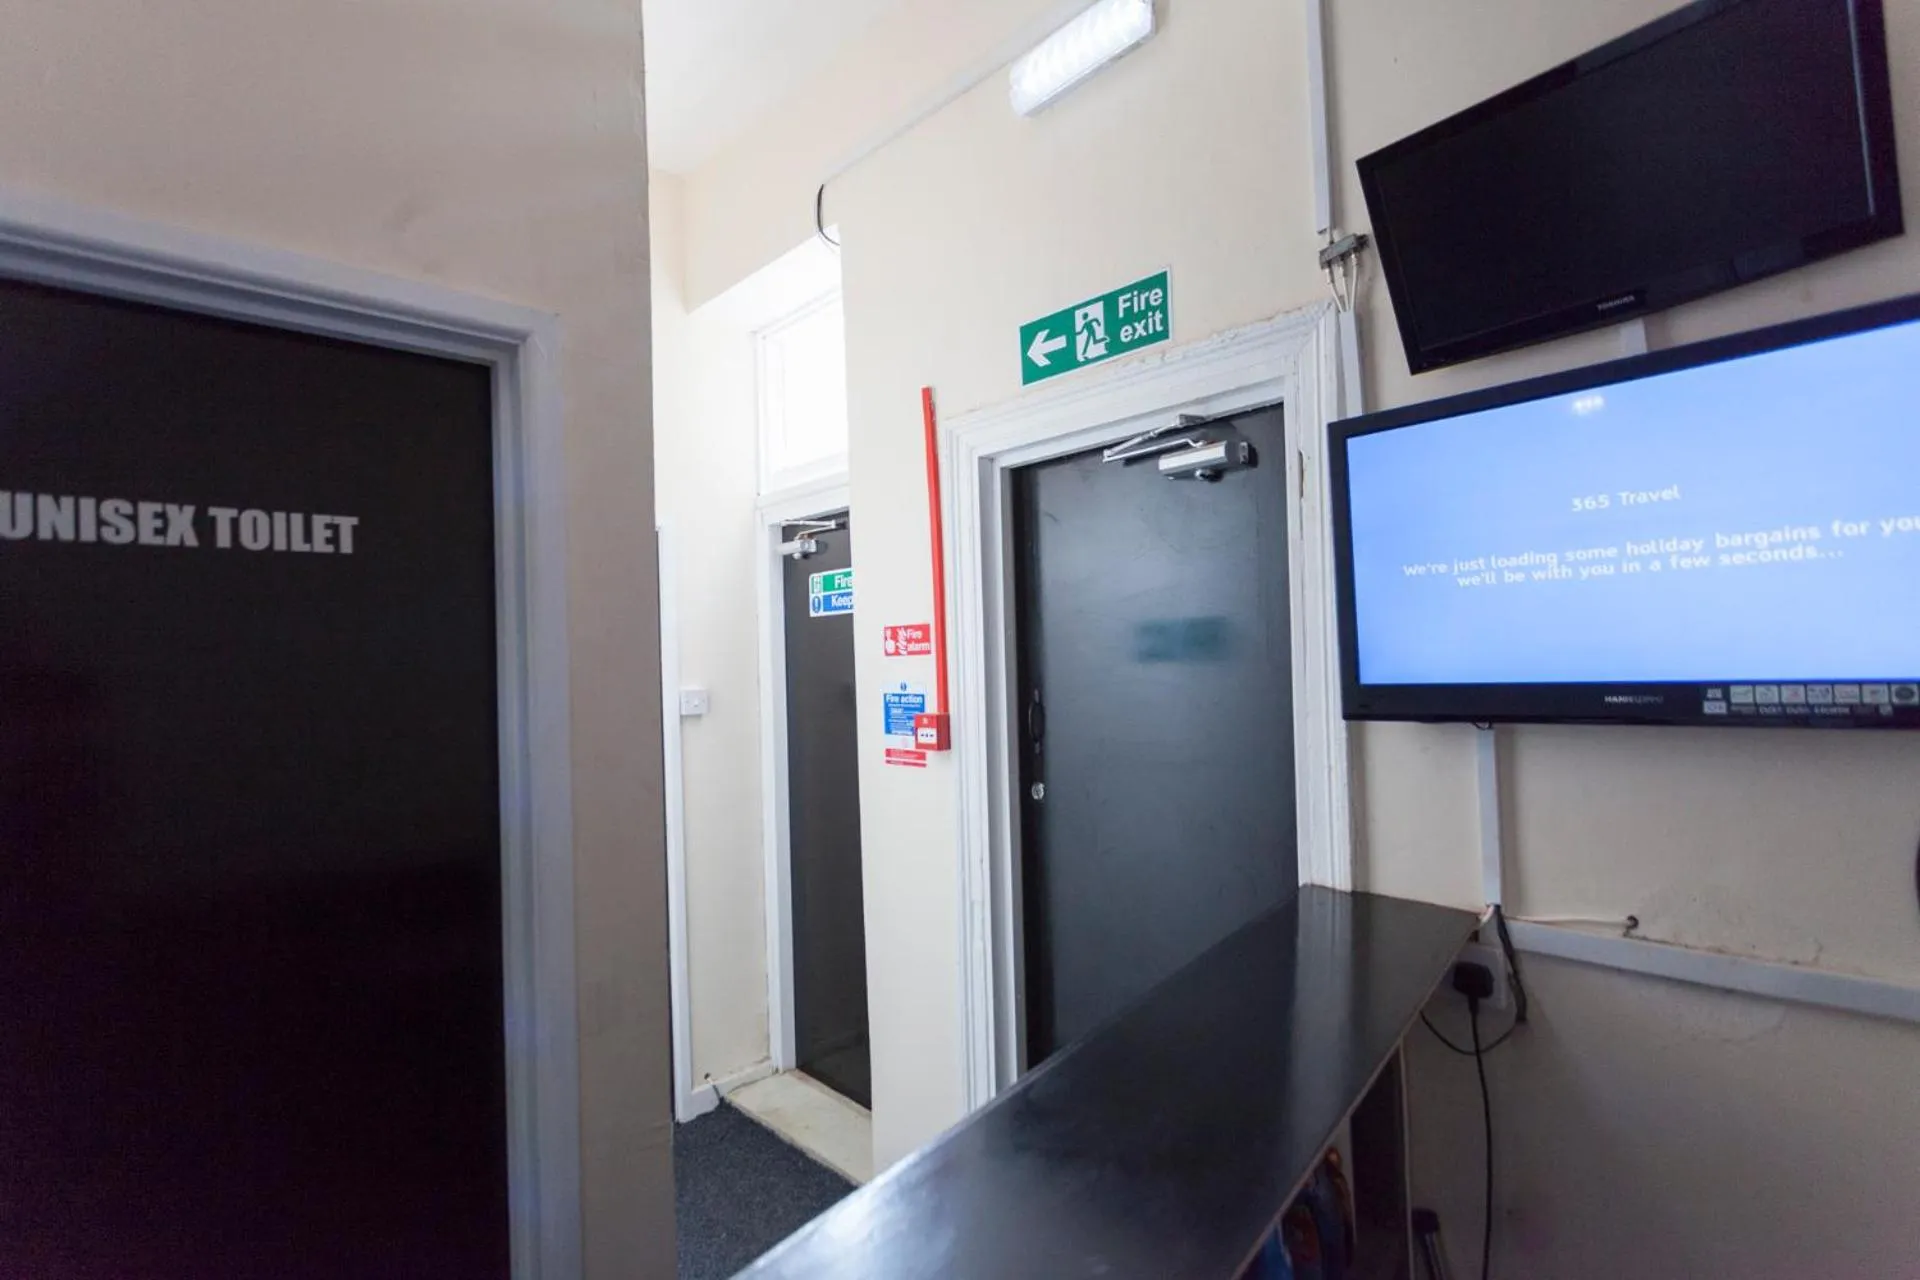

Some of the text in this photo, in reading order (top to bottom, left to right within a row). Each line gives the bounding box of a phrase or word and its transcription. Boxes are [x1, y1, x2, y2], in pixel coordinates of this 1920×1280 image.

[1117, 287, 1163, 318] Fire
[1119, 310, 1164, 343] exit
[1571, 485, 1681, 512] 365 Travel
[0, 490, 359, 553] UNISEX TOILET
[1402, 562, 1448, 576] We're
[1453, 557, 1485, 575] just
[1491, 551, 1557, 569] loading
[1565, 545, 1618, 561] some
[1626, 537, 1704, 557] holiday
[1715, 525, 1821, 549] bargains
[1831, 519, 1870, 537] for
[1456, 571, 1497, 588] we'll
[1504, 570, 1525, 583] be
[1532, 566, 1572, 581] with
[1580, 564, 1614, 581] you
[1622, 560, 1641, 573] in
[1649, 560, 1661, 571] a
[1669, 553, 1711, 570] few
[906, 641, 930, 651] alarm
[907, 628, 922, 640] Fire
[886, 694, 923, 704] Fire action
